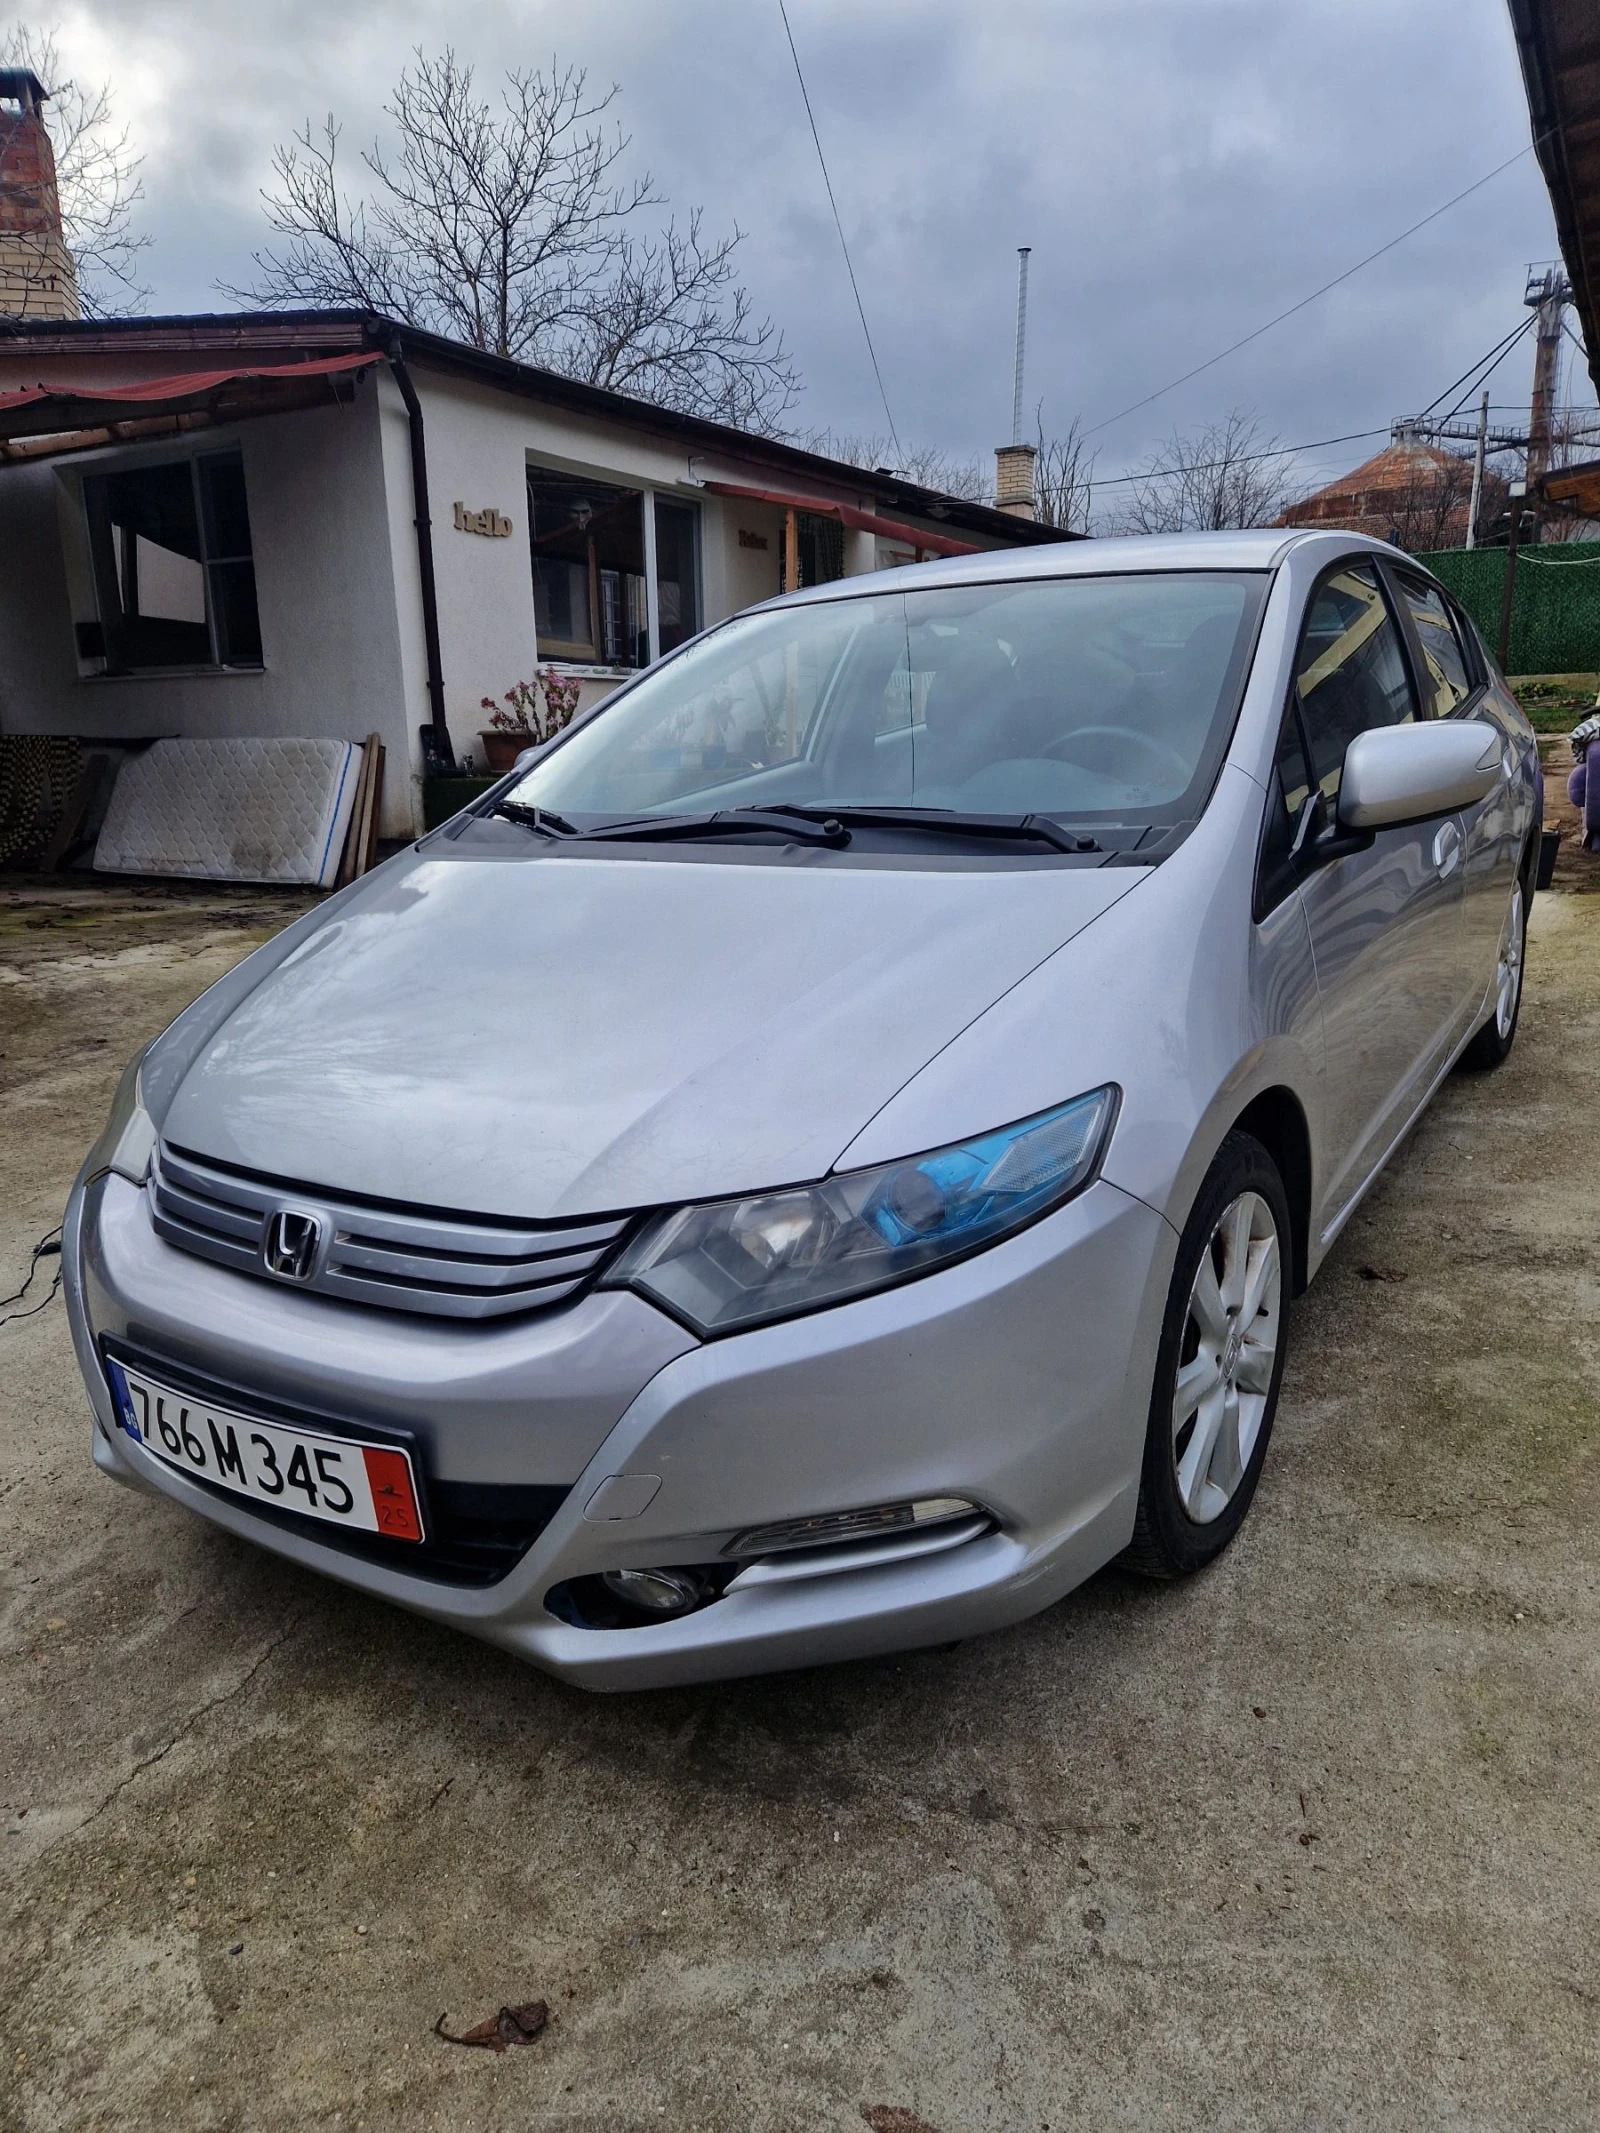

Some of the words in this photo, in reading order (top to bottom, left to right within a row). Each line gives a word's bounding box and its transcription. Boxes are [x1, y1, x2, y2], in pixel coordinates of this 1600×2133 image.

[453, 501, 513, 537] hello
[123, 1407, 139, 1430] BG
[381, 1504, 409, 1528] 25
